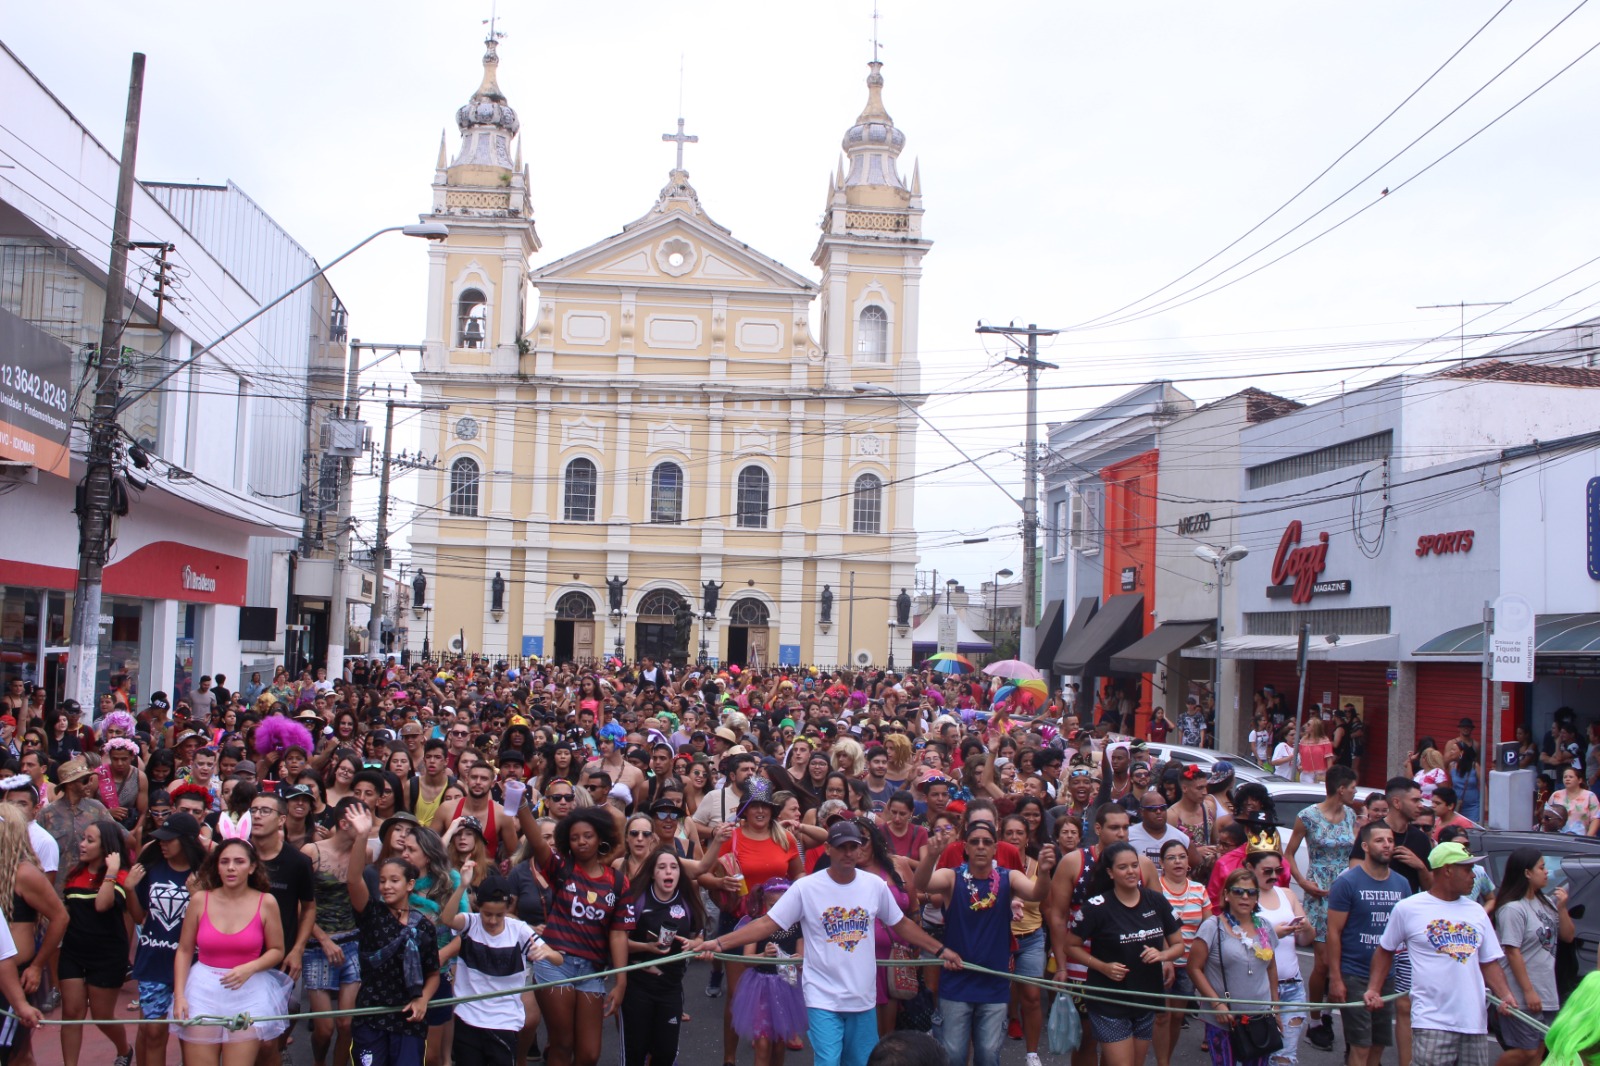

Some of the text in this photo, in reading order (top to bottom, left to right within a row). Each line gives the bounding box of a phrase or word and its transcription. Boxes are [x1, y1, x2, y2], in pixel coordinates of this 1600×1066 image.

[1, 363, 67, 413] 12 3642.8243
[0, 391, 22, 411] Unidade
[1415, 529, 1475, 558] SPORTS
[1271, 519, 1329, 604] Cozzi
[192, 571, 216, 592] Bradesco
[1313, 582, 1347, 593] MAGAZINE
[1495, 656, 1520, 664] AQUI
[1507, 752, 1515, 762] P
[1359, 890, 1402, 901] YESTERDAY
[1371, 912, 1391, 922] TODA
[824, 918, 869, 936] CARNAVAL
[1428, 932, 1479, 947] CARNAVAL
